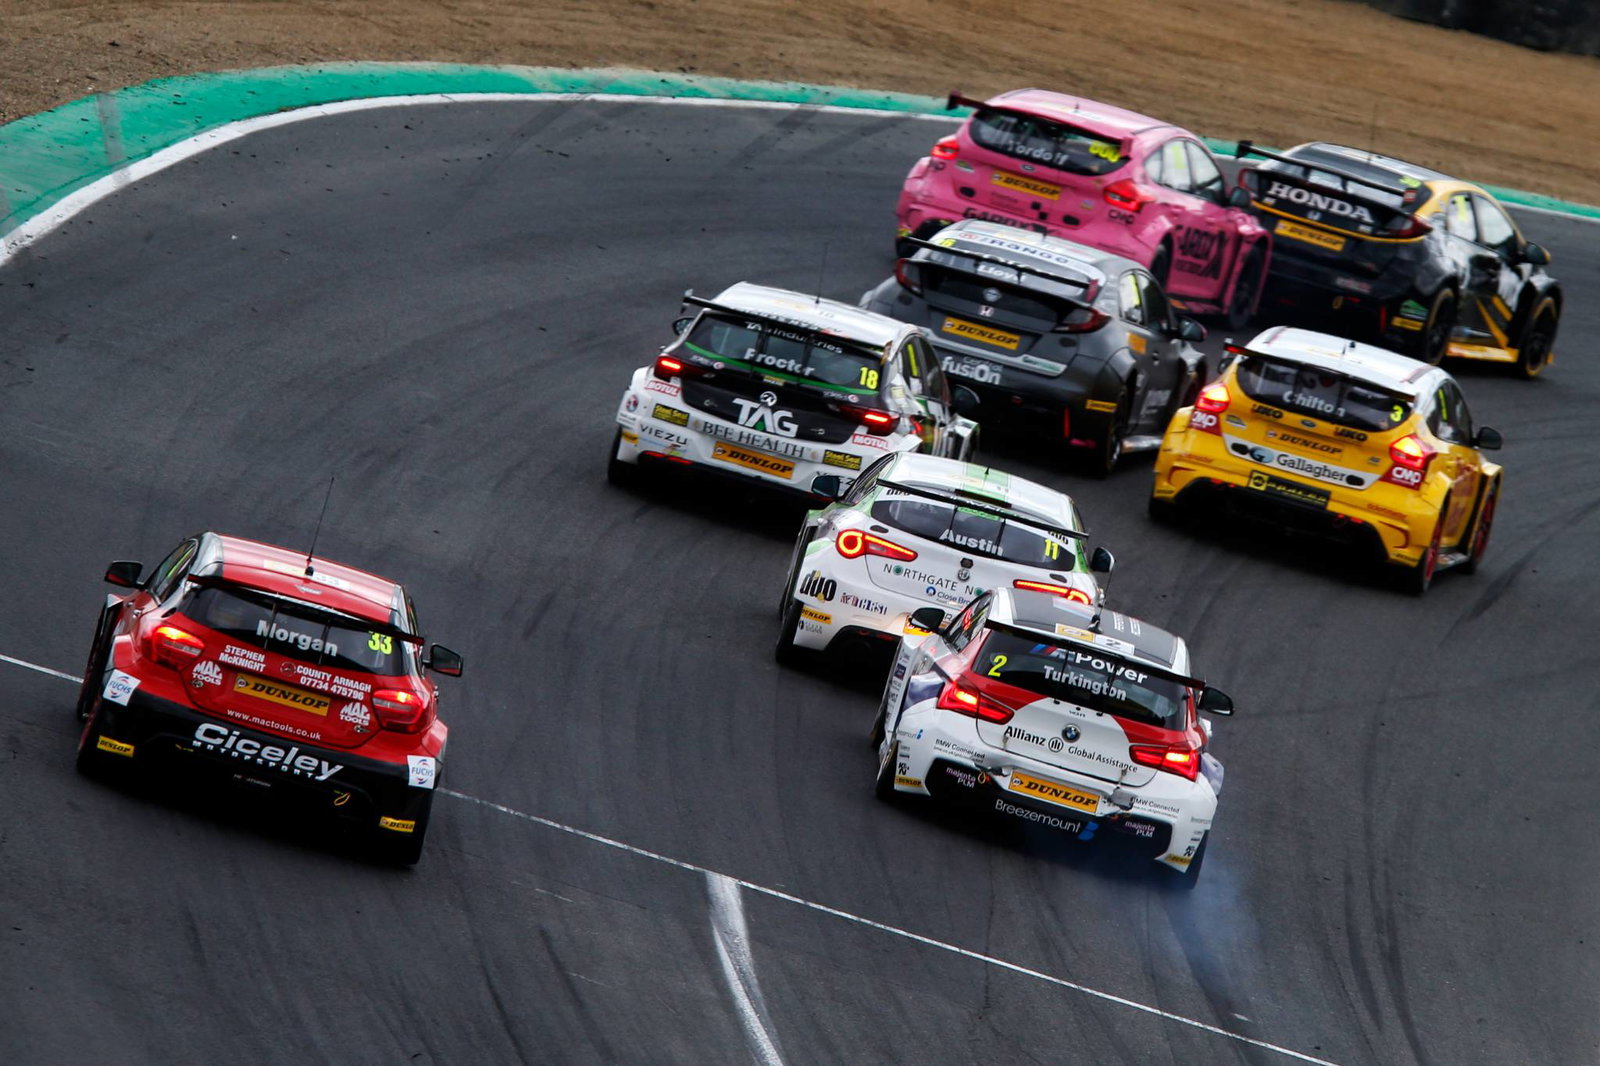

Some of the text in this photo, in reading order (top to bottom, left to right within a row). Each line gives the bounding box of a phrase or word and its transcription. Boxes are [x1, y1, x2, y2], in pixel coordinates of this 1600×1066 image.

[1003, 176, 1060, 195] DUNLOP
[1267, 181, 1375, 223] HONDA
[956, 324, 1018, 344] DUNLOP
[648, 382, 679, 396] MOTUL
[860, 366, 879, 390] 18
[1282, 390, 1346, 417] Chilton
[1389, 404, 1405, 422] 3
[732, 397, 799, 438] TAG
[640, 424, 689, 446] VIEZU
[702, 421, 806, 458] BEE HEALTH
[854, 435, 888, 449] MOTUL
[1279, 433, 1343, 455] DUNLOP
[728, 450, 793, 473] DUNLOP
[1276, 453, 1345, 482] Gallagher
[938, 528, 1004, 557] Austin
[1044, 538, 1059, 561] 11
[883, 563, 958, 592] NORTHGATE
[937, 592, 957, 602] Close
[256, 619, 338, 657] Morgan
[367, 630, 392, 655] 33
[218, 652, 266, 673] McKNIGHT
[224, 644, 265, 663] STEPHEN
[193, 660, 223, 681] MAC
[987, 655, 1008, 677] 2
[1075, 651, 1148, 685] Power
[108, 680, 132, 694] FUCHS
[192, 672, 222, 686] TOOLS
[296, 665, 372, 693] COUNTY ARMAGH
[300, 675, 329, 691] 07734
[1043, 665, 1127, 701] Turkington
[251, 681, 329, 709] DUNLOP
[340, 701, 370, 721] MAC
[340, 713, 370, 727] TOOLS
[226, 708, 321, 741] www.mactools.co.uk
[100, 739, 131, 753] DUNLOP
[935, 738, 952, 749] BMW
[1003, 726, 1047, 746] Allianz
[194, 722, 344, 782] Ciceley
[1068, 745, 1138, 773] Global Assistance
[411, 766, 434, 778] FUCHS
[946, 767, 977, 783] majenta
[957, 776, 975, 789] PLM
[1023, 781, 1098, 807] DUNLOP
[994, 799, 1081, 834] Breezemount
[1131, 797, 1149, 806] BMW
[1148, 801, 1180, 814] Connected
[1124, 821, 1156, 832] majenta
[1136, 829, 1154, 838] PLM
